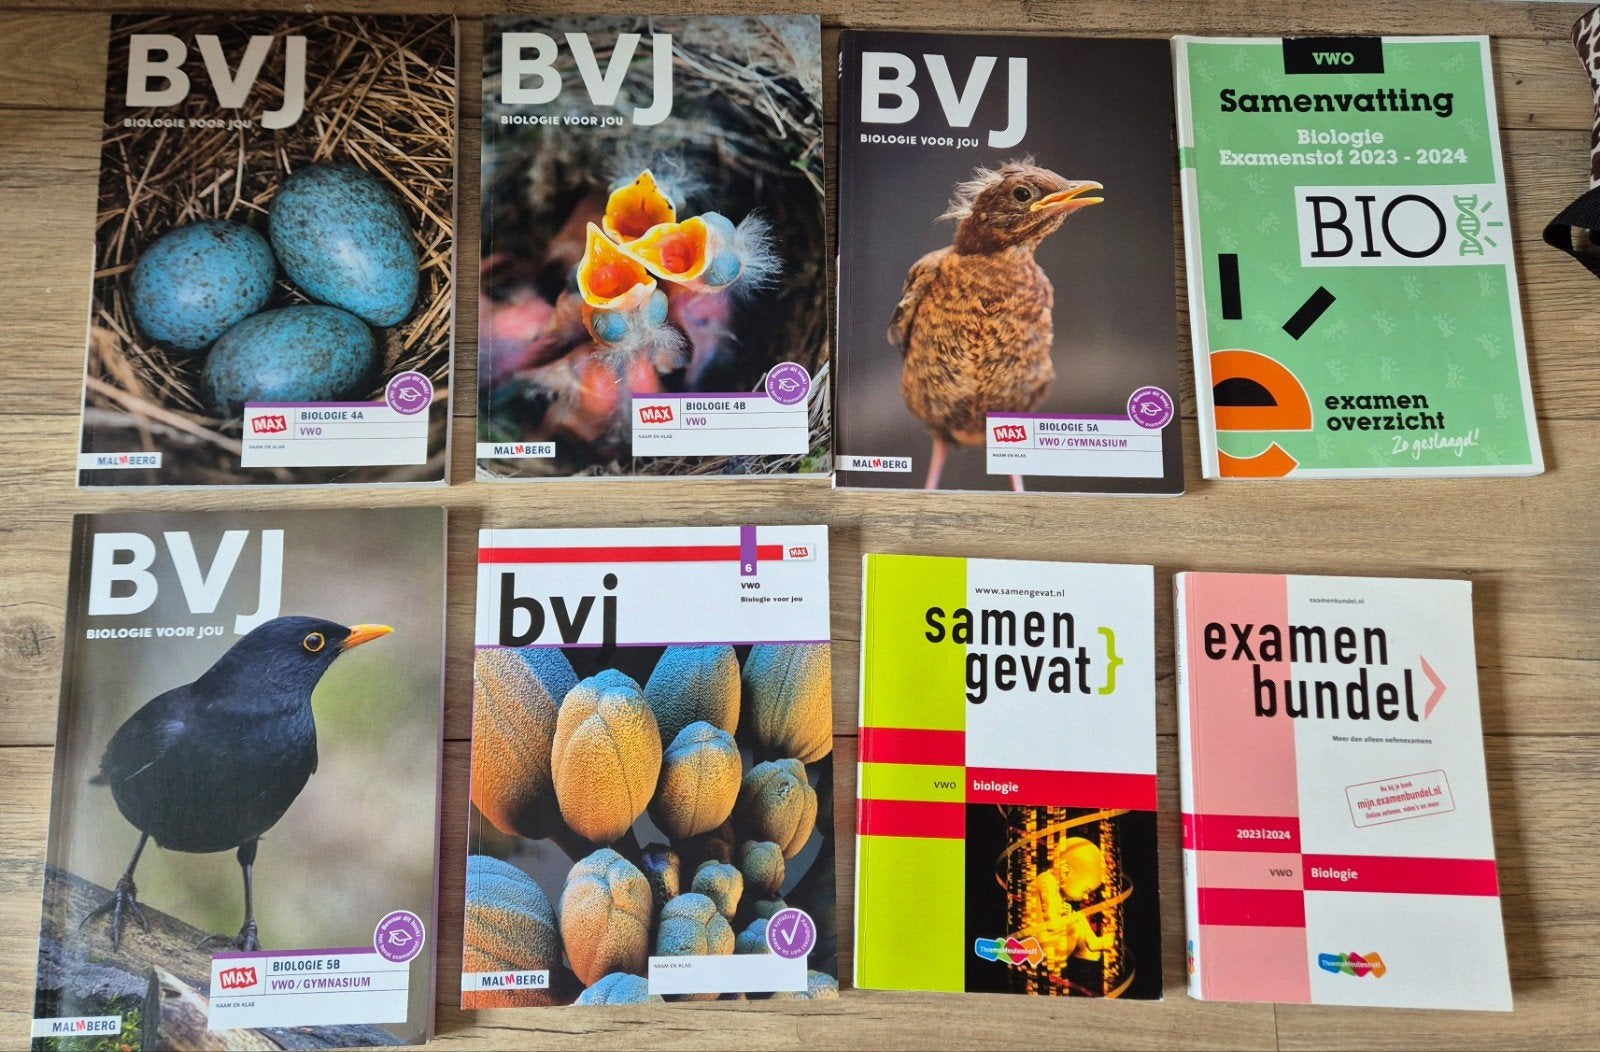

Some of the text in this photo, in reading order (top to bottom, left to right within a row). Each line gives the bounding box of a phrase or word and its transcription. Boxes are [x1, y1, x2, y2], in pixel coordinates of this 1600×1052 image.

[1312, 52, 1355, 66] VWO
[125, 34, 308, 130] BVJ
[501, 32, 673, 126] BVJ
[860, 51, 1028, 149] BVJ
[1219, 88, 1454, 118] Samenvatting
[123, 118, 252, 131] BIOLOGIE VOOR JOU
[501, 115, 624, 128] BIOLOGIE VOOR JOU
[860, 133, 979, 149] BIOLOGIE VOOR JOU
[1296, 128, 1384, 148] Biologie
[1219, 149, 1344, 166] Examenstof
[1348, 148, 1398, 165] 2023
[1415, 148, 1469, 165] 2024
[1305, 194, 1447, 259] BIO
[685, 401, 746, 411] BIOLOGIE 4B
[1324, 394, 1429, 411] examen
[300, 411, 364, 421] BIOLOGIE 4A
[639, 405, 674, 423] MAX
[252, 416, 287, 432] MAX
[685, 417, 707, 426] VWO
[1039, 422, 1099, 432] BIOLOGIE 5A
[1326, 411, 1446, 432] overzicht
[300, 427, 322, 436] VWO
[993, 425, 1028, 443] MAX
[493, 444, 551, 455] MALMBERG
[1411, 428, 1481, 460] geslaagd!
[98, 455, 156, 466] MALMBERG
[852, 458, 908, 469] MALMBERG
[788, 547, 809, 558] MAX
[744, 563, 753, 573] 6
[88, 529, 285, 636] BVJ
[740, 582, 761, 590] VWO
[791, 595, 803, 603] jou
[974, 587, 1066, 598] www.samengevat.nl
[1308, 597, 1365, 605] examenbundel.nl
[500, 572, 619, 648] bvj
[86, 625, 224, 640] BIOLOGIE VOOR JOU
[925, 606, 1075, 649] samen
[1203, 621, 1389, 666] examen
[965, 646, 1092, 705] gevat
[1252, 663, 1420, 723] bundel
[1384, 737, 1433, 745] oefenexamens
[933, 781, 957, 789] vwo
[972, 779, 1019, 795] biologie
[1379, 785, 1388, 793] Nu
[1387, 784, 1395, 792] bij
[1394, 783, 1400, 792] je
[1357, 784, 1443, 811] mijn.examenbundel.nl
[1269, 869, 1293, 877] vwo
[1311, 867, 1358, 882] Biologie
[773, 914, 795, 928] syllabus
[273, 959, 341, 972] BIOLOGIE 5B
[219, 966, 258, 990] MAX
[482, 973, 545, 987] MALMBERG
[52, 1019, 116, 1033] MALMBERG
